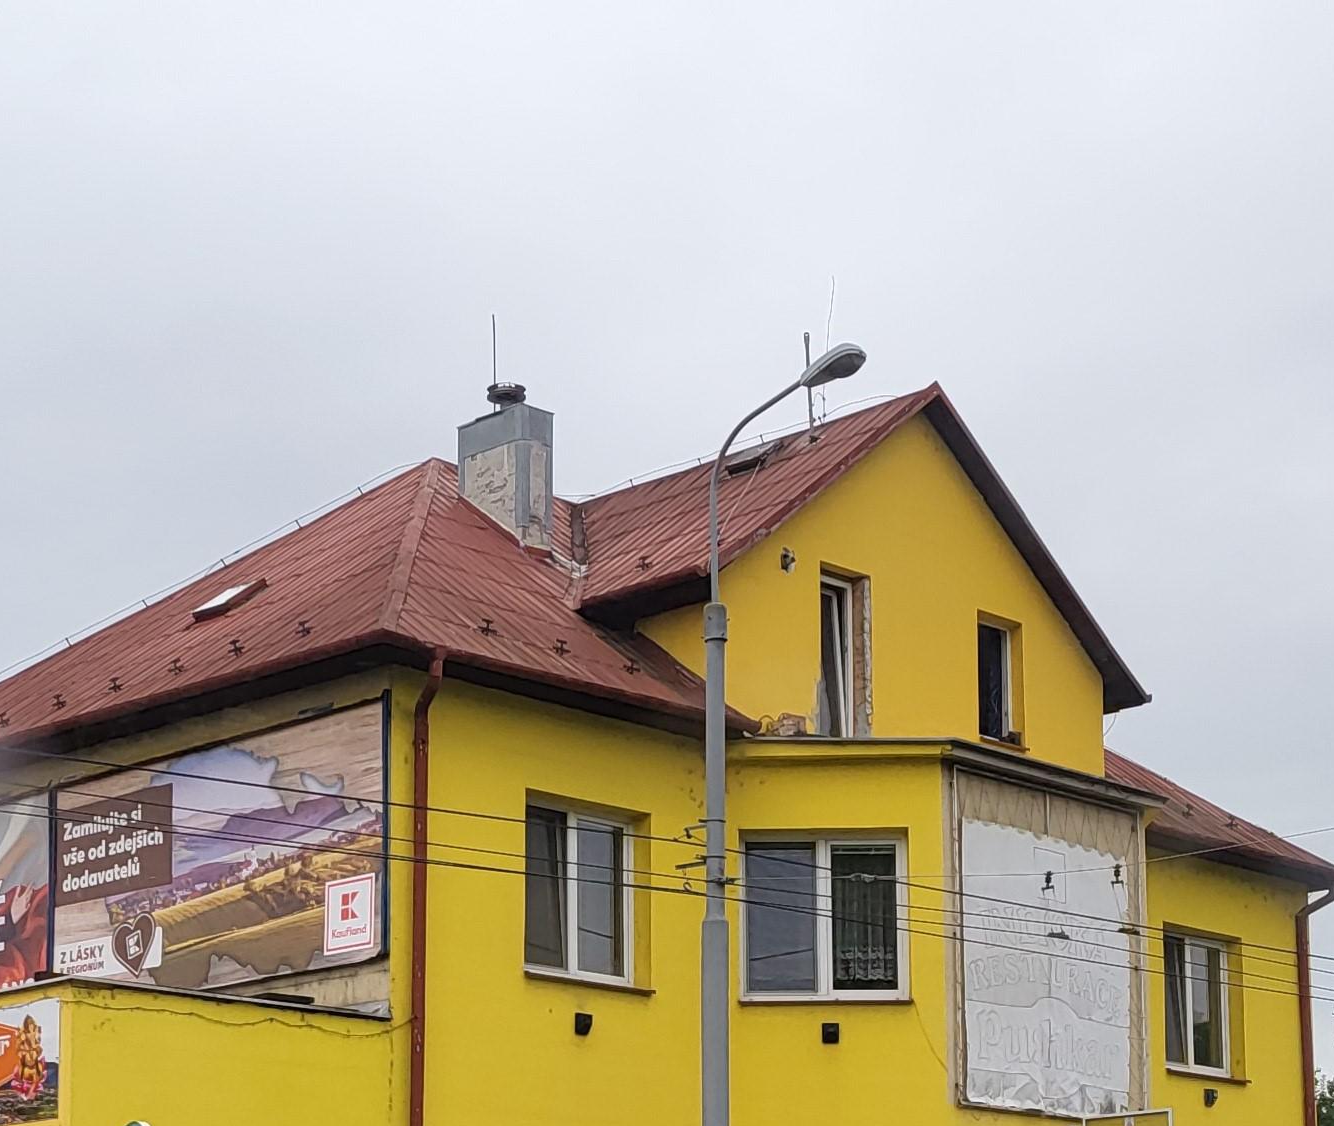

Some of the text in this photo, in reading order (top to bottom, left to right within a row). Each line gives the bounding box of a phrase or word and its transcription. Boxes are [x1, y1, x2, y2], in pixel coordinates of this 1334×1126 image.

[63, 804, 142, 842] Zamilujte si
[63, 826, 163, 867] vše od zdejších
[62, 857, 140, 893] dodavatelů
[331, 923, 367, 939] Kaufland
[60, 944, 104, 965] Z LÁSKY
